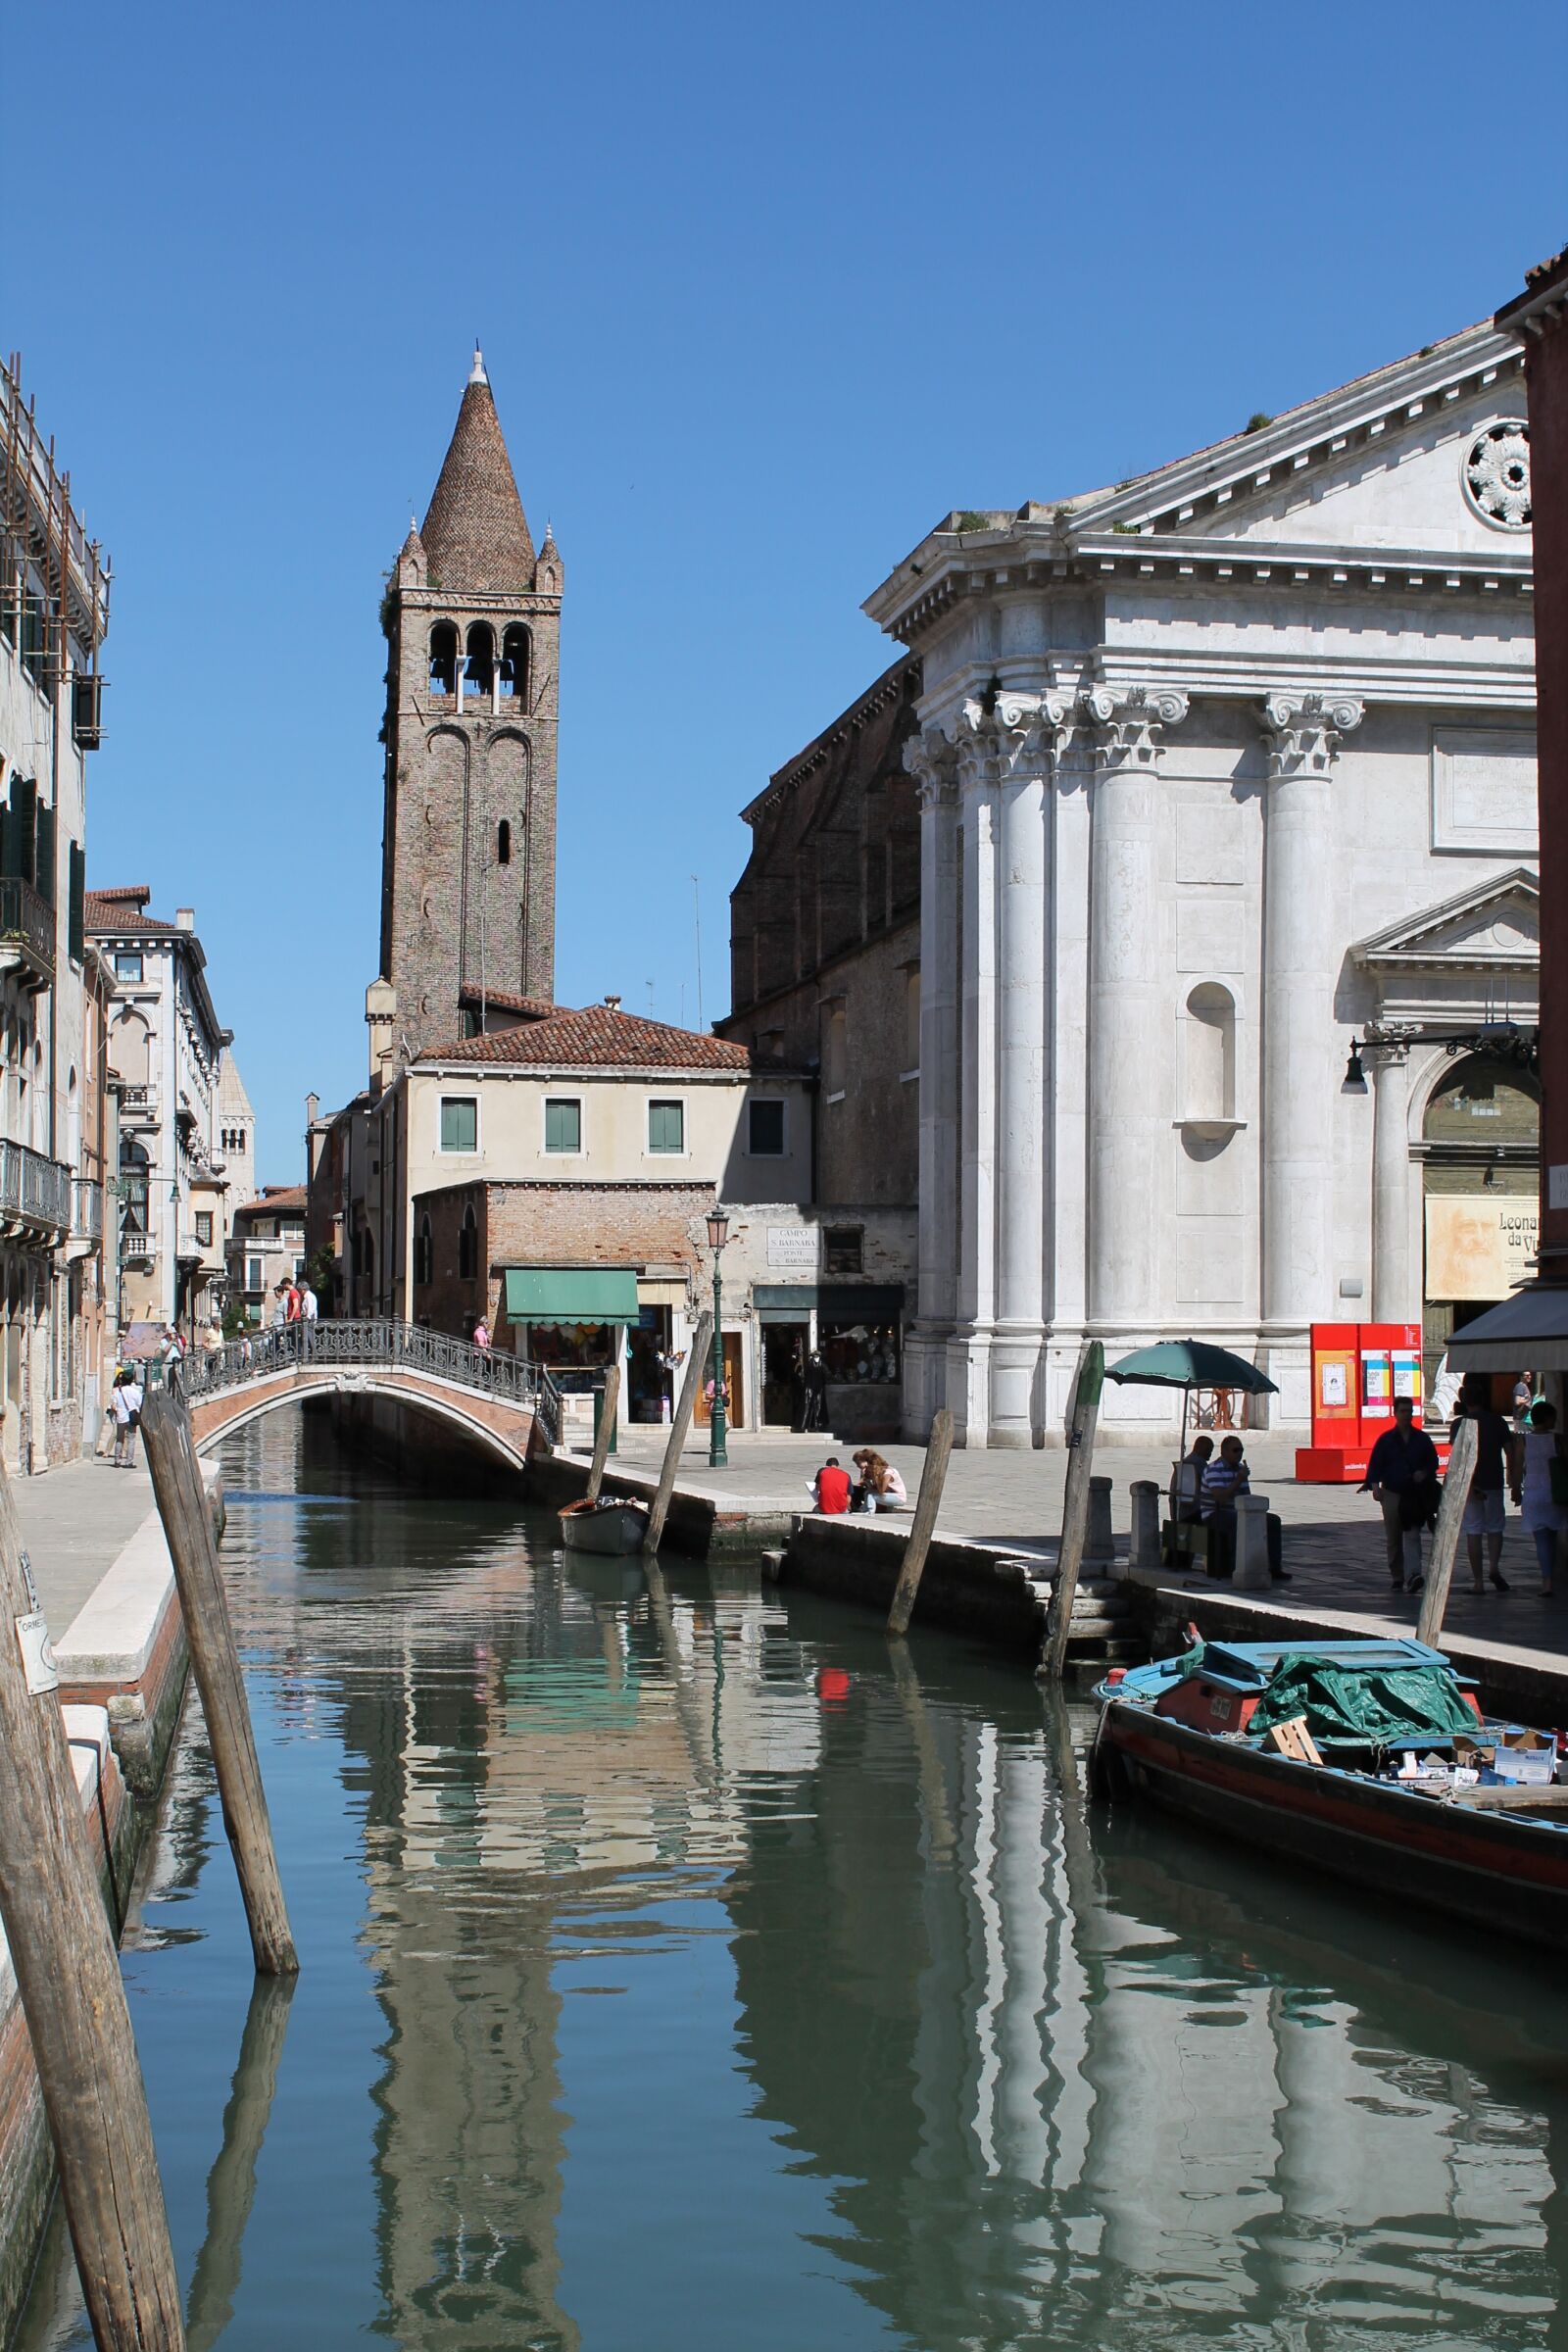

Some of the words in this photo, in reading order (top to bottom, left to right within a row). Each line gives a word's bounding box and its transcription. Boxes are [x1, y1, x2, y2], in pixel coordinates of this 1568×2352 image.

[1507, 1232, 1521, 1246] da
[1523, 1235, 1538, 1252] Vi
[23, 1618, 46, 1633] ORME
